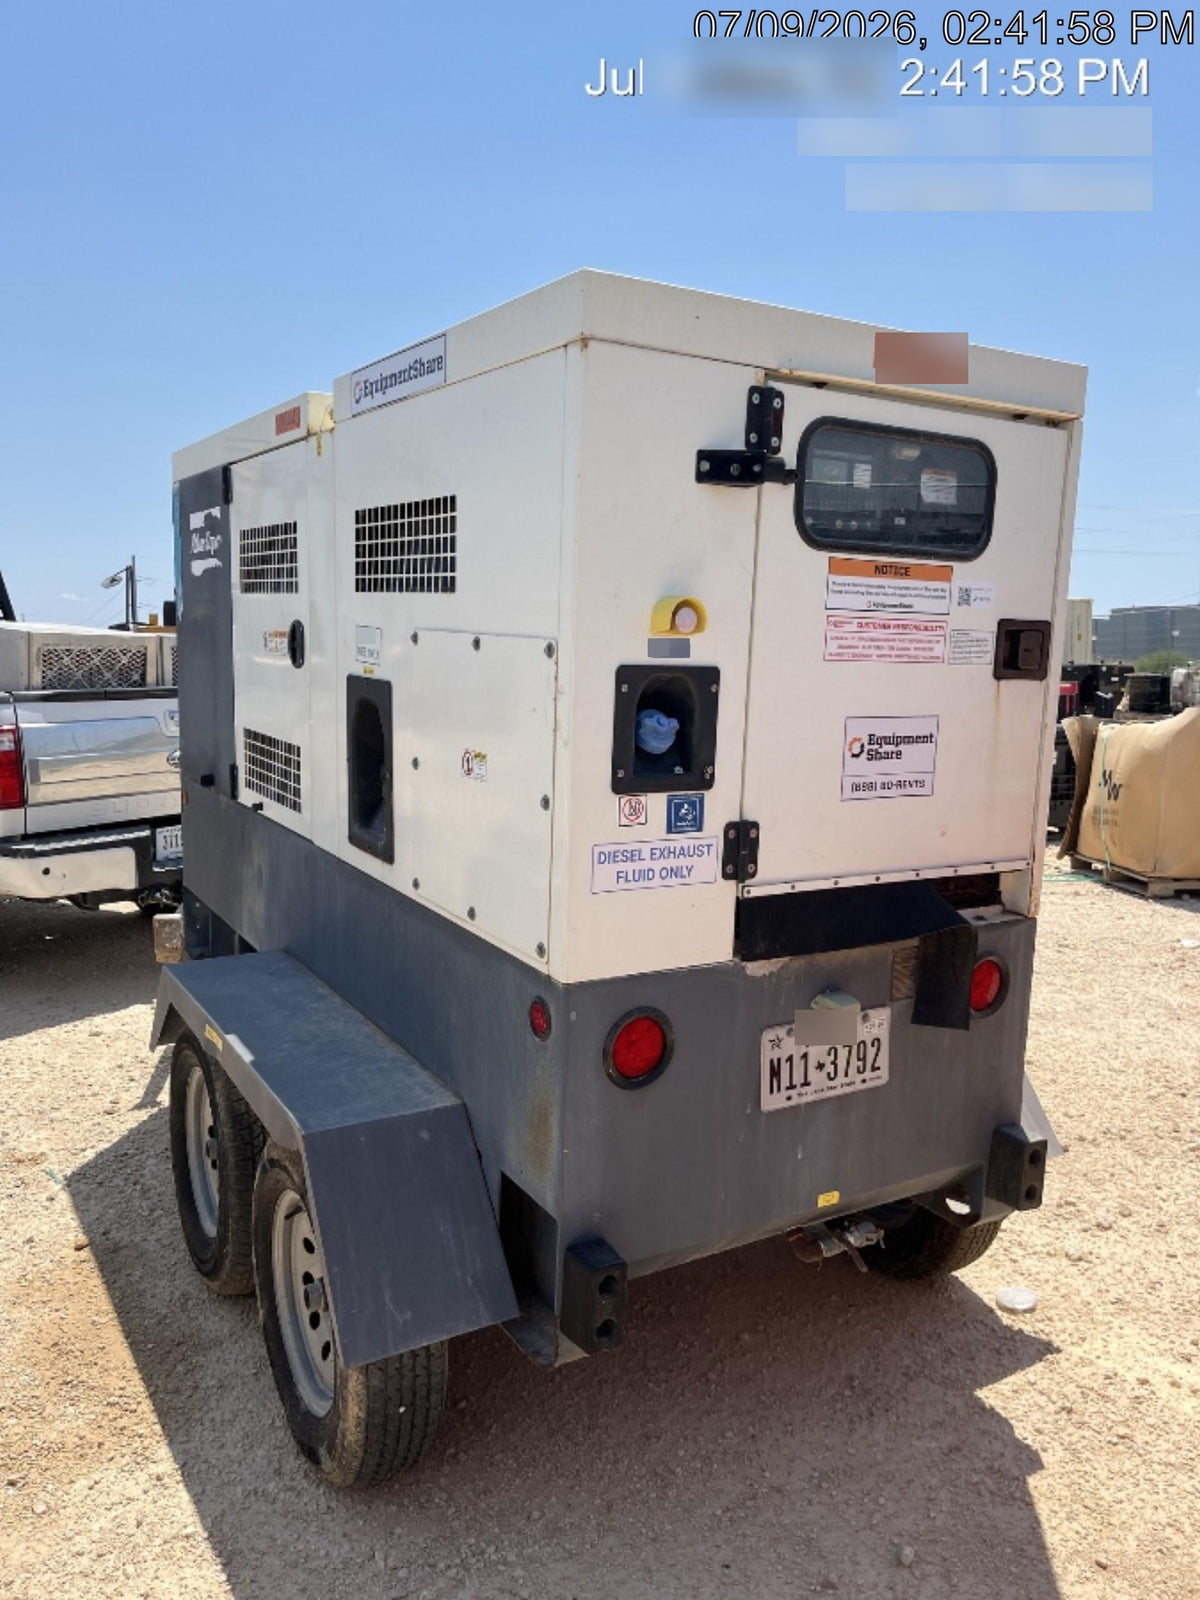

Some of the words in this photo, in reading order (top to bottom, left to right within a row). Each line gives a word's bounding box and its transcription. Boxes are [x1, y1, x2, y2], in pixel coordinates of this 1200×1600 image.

[363, 355, 444, 400] EquipmentShare
[874, 565, 911, 577] NOTICE
[867, 732, 934, 749] Equipment
[866, 748, 903, 762] Share
[597, 849, 646, 865] DIESEL
[650, 843, 713, 861] EXHAUST
[616, 868, 655, 884] FLUID
[659, 864, 694, 881] ONLY
[826, 1037, 882, 1082] 3792
